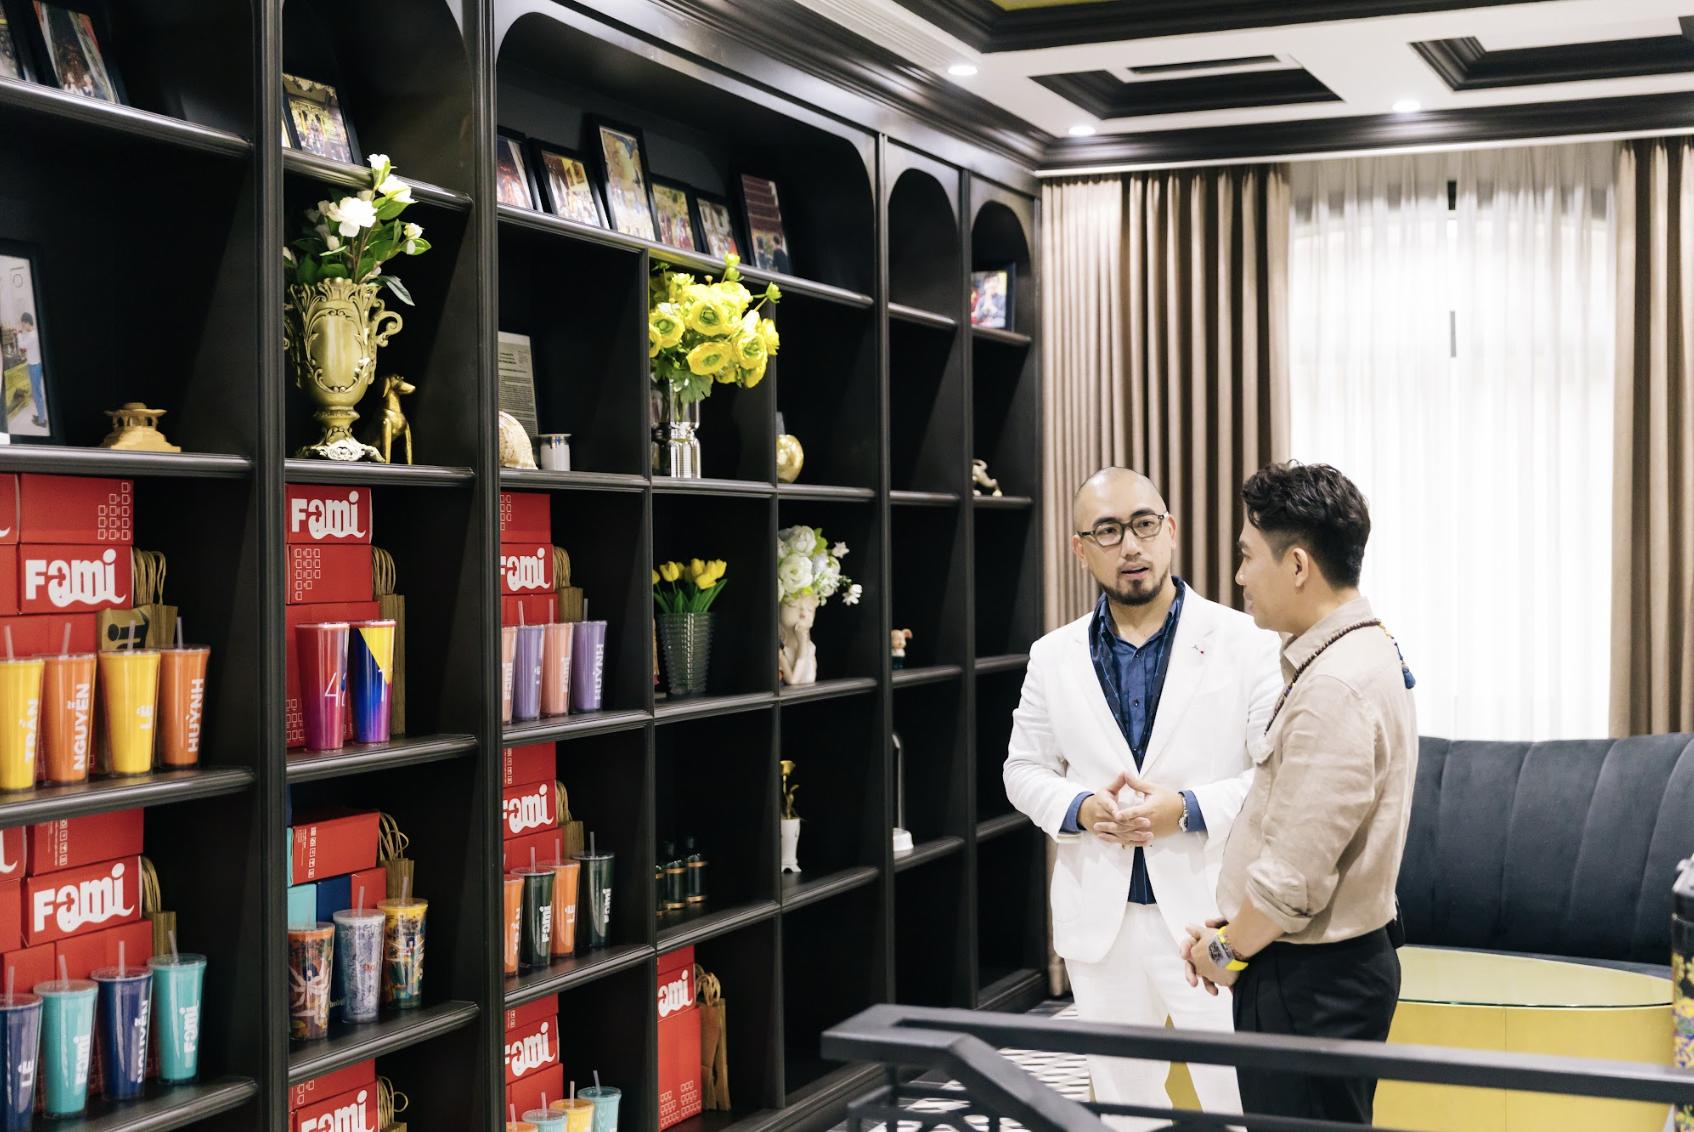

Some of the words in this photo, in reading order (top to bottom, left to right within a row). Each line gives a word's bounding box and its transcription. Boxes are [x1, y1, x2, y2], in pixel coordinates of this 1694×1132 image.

[291, 490, 366, 540] Fami
[25, 548, 126, 607] Fami
[67, 683, 90, 770] NGUYỄN
[185, 678, 204, 753] HUỲNH
[34, 862, 135, 933] Fami
[657, 969, 693, 1017] ami
[179, 1000, 199, 1053] Fami
[17, 1060, 35, 1087] LÊ
